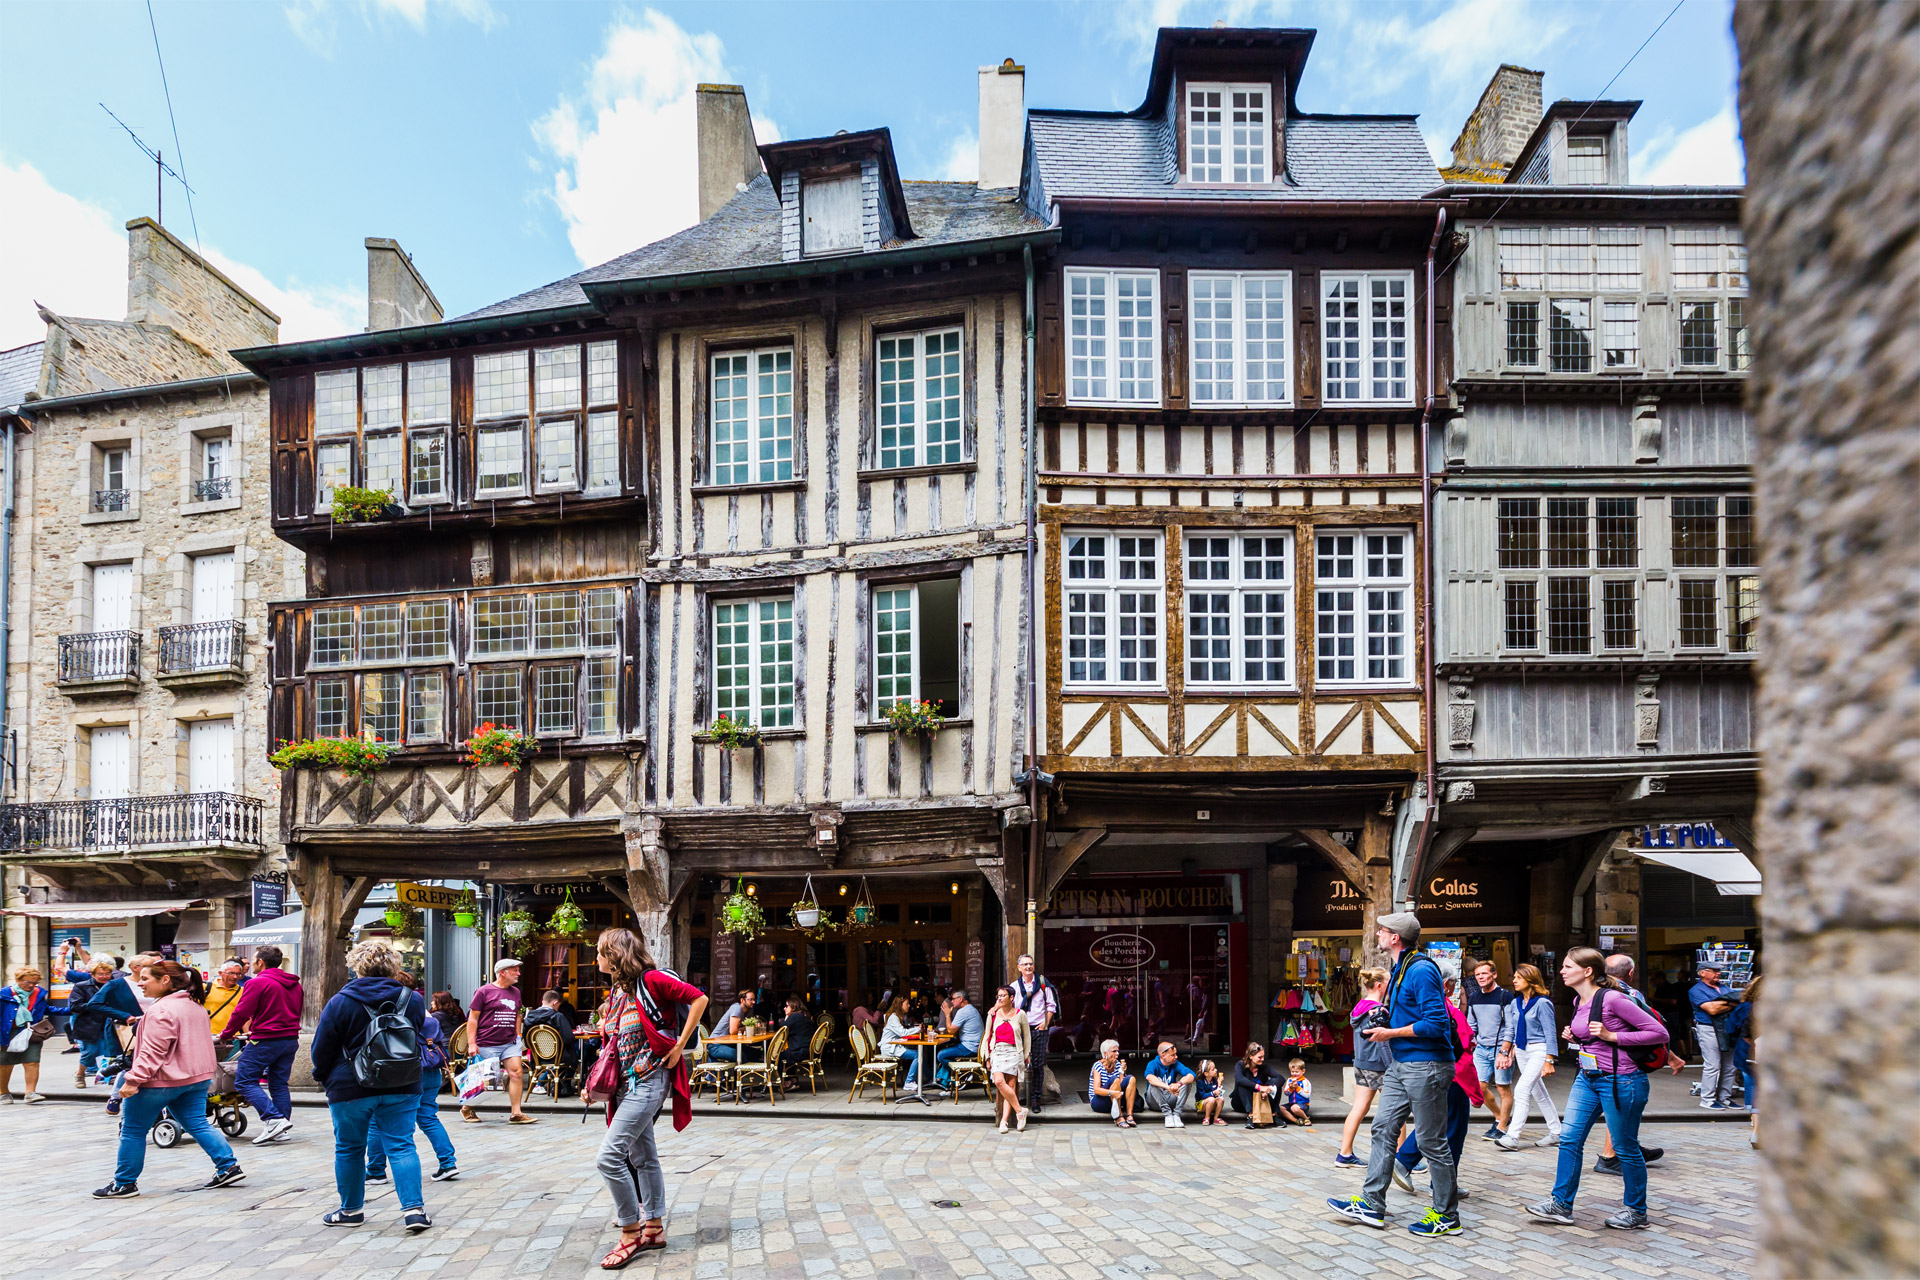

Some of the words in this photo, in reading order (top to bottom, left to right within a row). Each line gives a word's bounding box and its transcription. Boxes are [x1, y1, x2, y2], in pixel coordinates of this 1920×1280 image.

[1644, 823, 1675, 848] LE
[533, 883, 591, 896] Crêprie
[1430, 877, 1479, 897] Colas
[1051, 889, 1127, 910] RTISAN
[1325, 903, 1358, 914] Produits
[1445, 901, 1483, 911] Souvenirs
[1099, 946, 1113, 955] des
